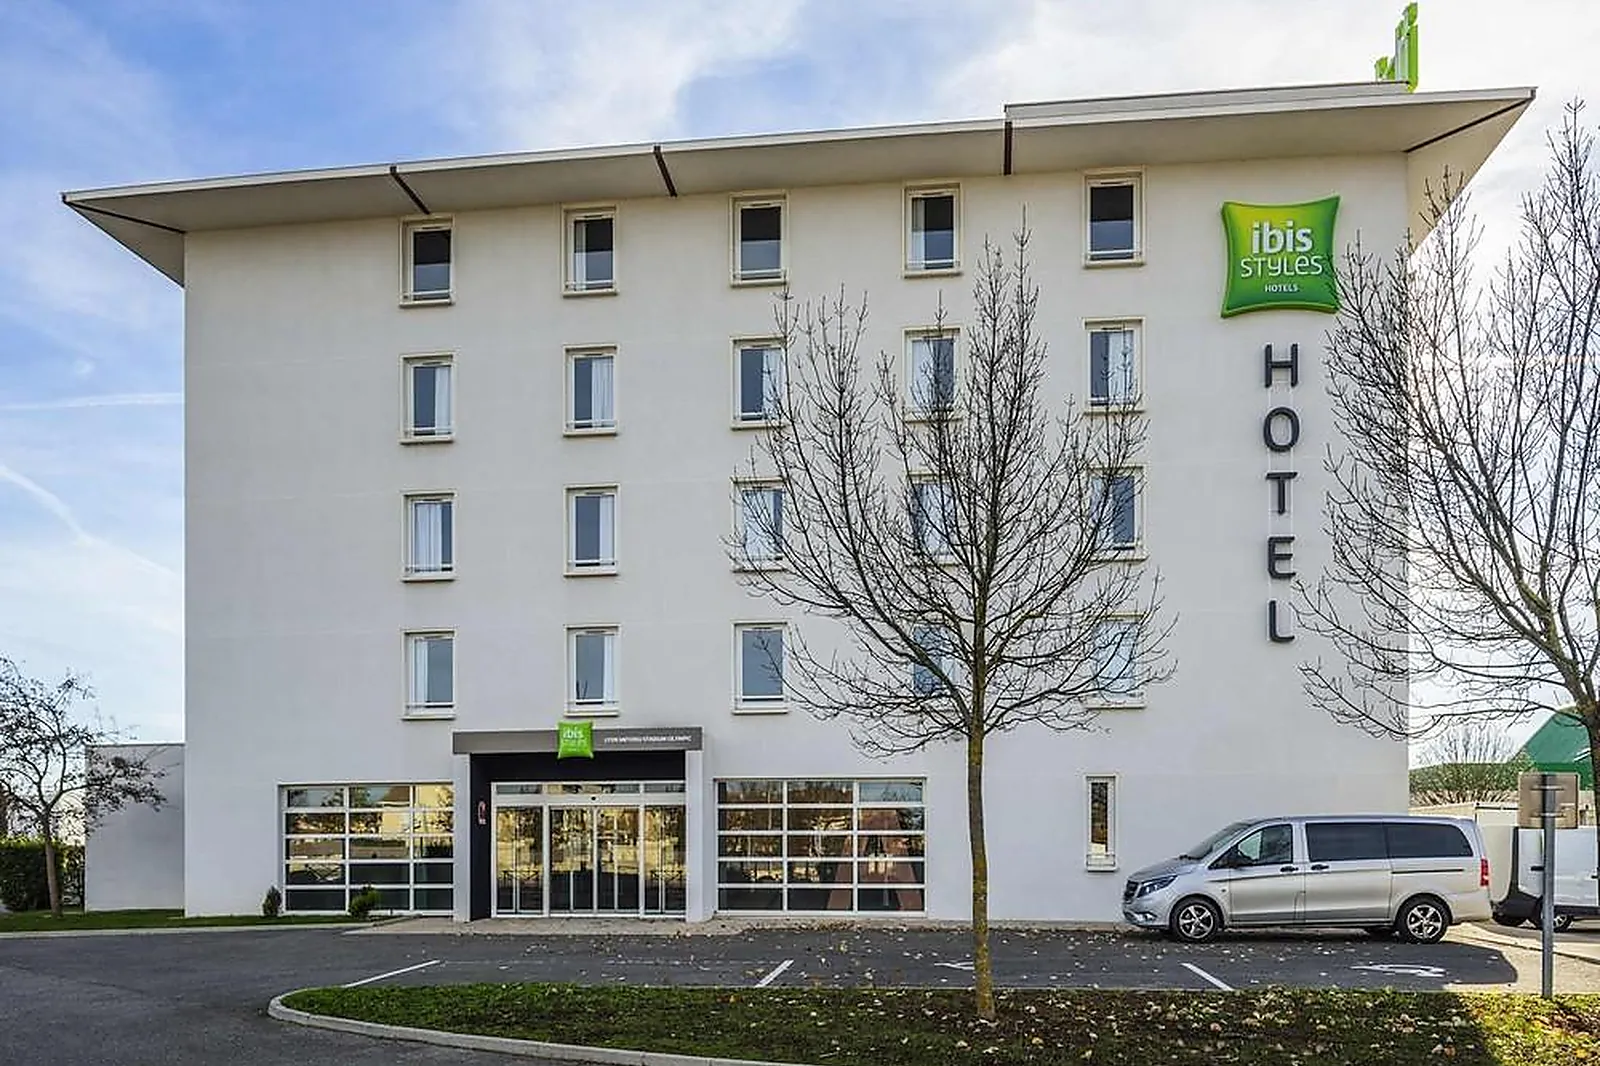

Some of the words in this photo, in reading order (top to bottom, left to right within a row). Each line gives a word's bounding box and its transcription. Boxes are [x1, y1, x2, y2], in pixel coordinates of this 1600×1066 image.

[1252, 220, 1313, 254] ibis
[1264, 283, 1299, 293] HOTELS
[1263, 343, 1300, 642] HOTEL
[563, 726, 584, 738] ibis
